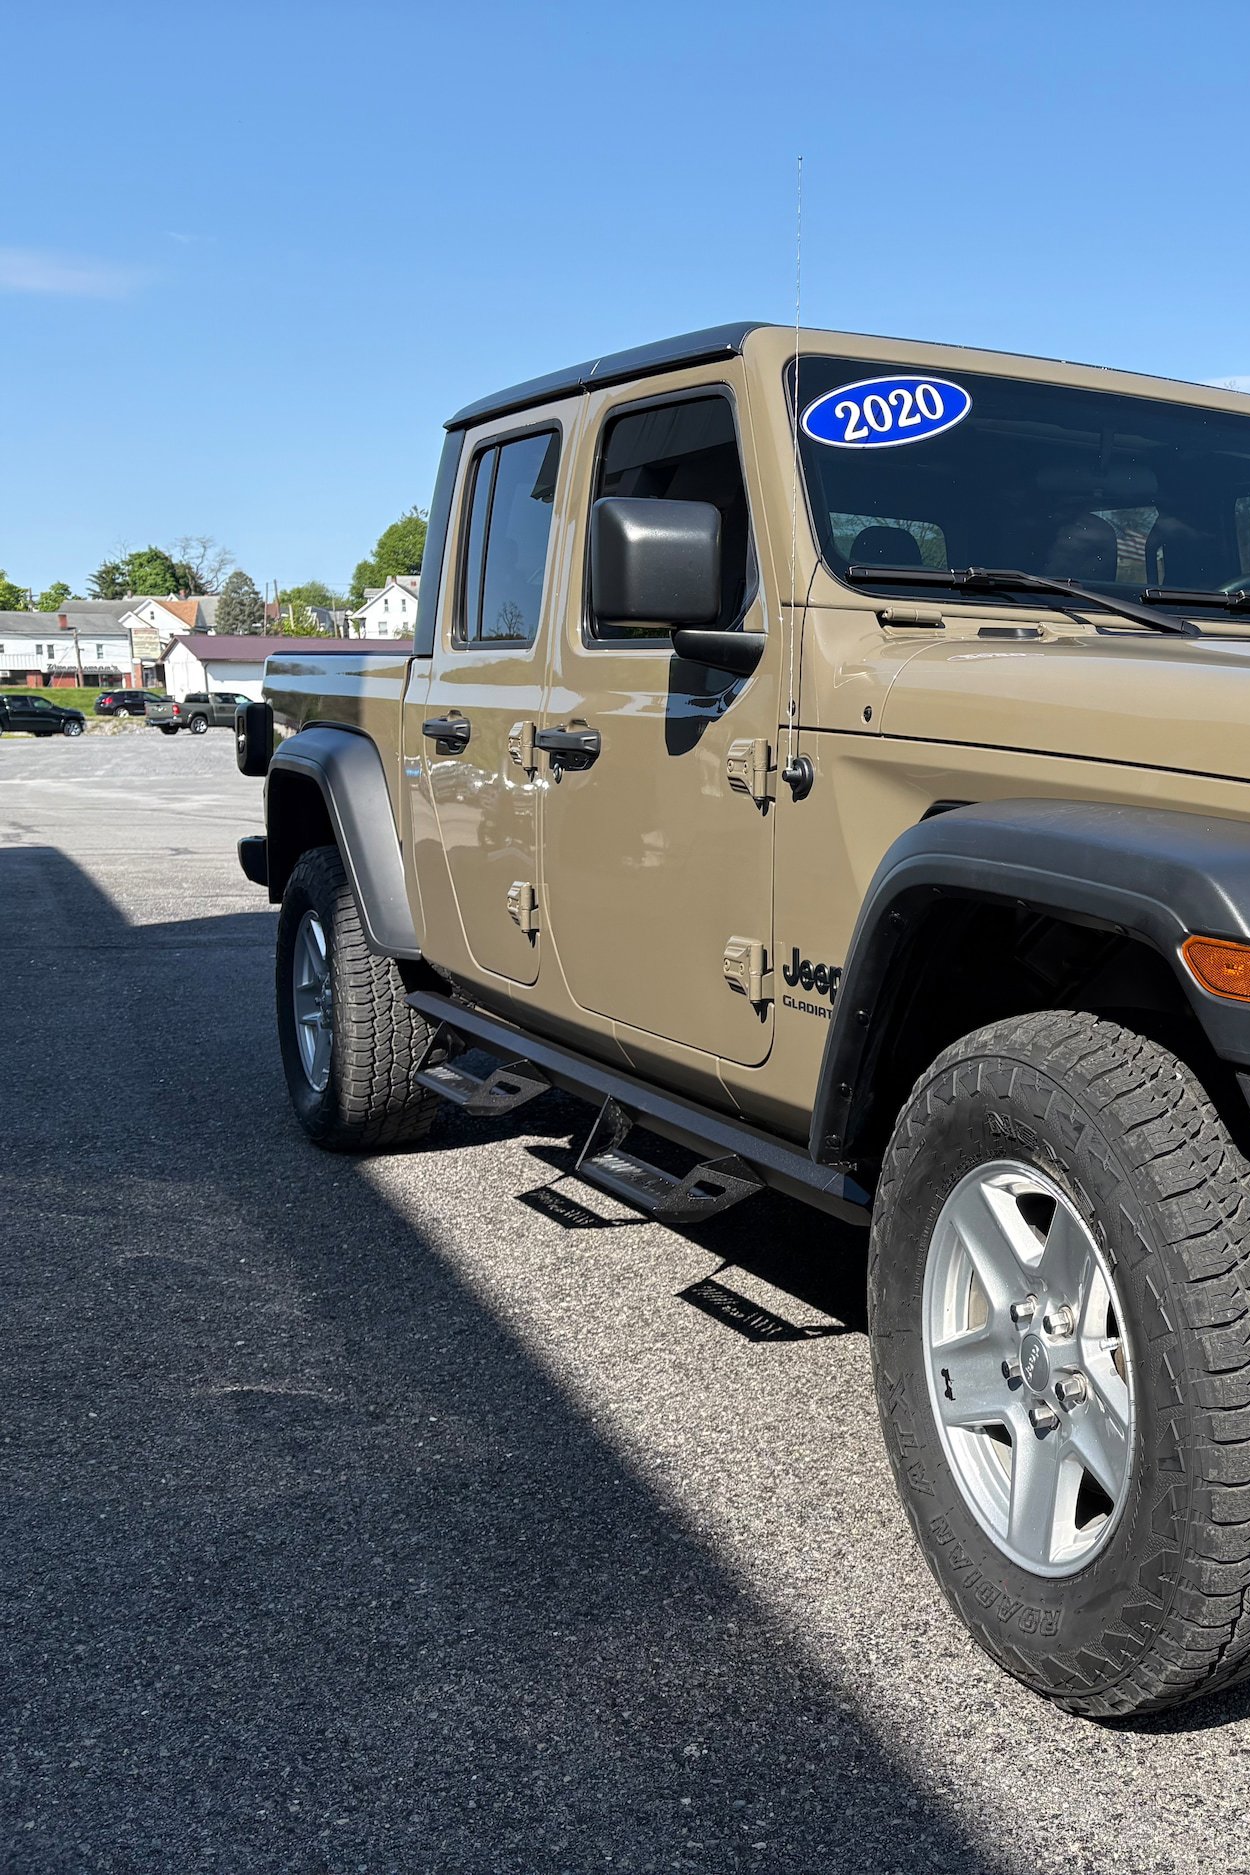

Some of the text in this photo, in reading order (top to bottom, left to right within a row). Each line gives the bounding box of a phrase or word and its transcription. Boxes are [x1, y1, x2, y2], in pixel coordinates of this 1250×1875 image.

[834, 383, 945, 442] 2020
[782, 946, 843, 1006] Jeep
[928, 1514, 1063, 1638] ROADIAN
